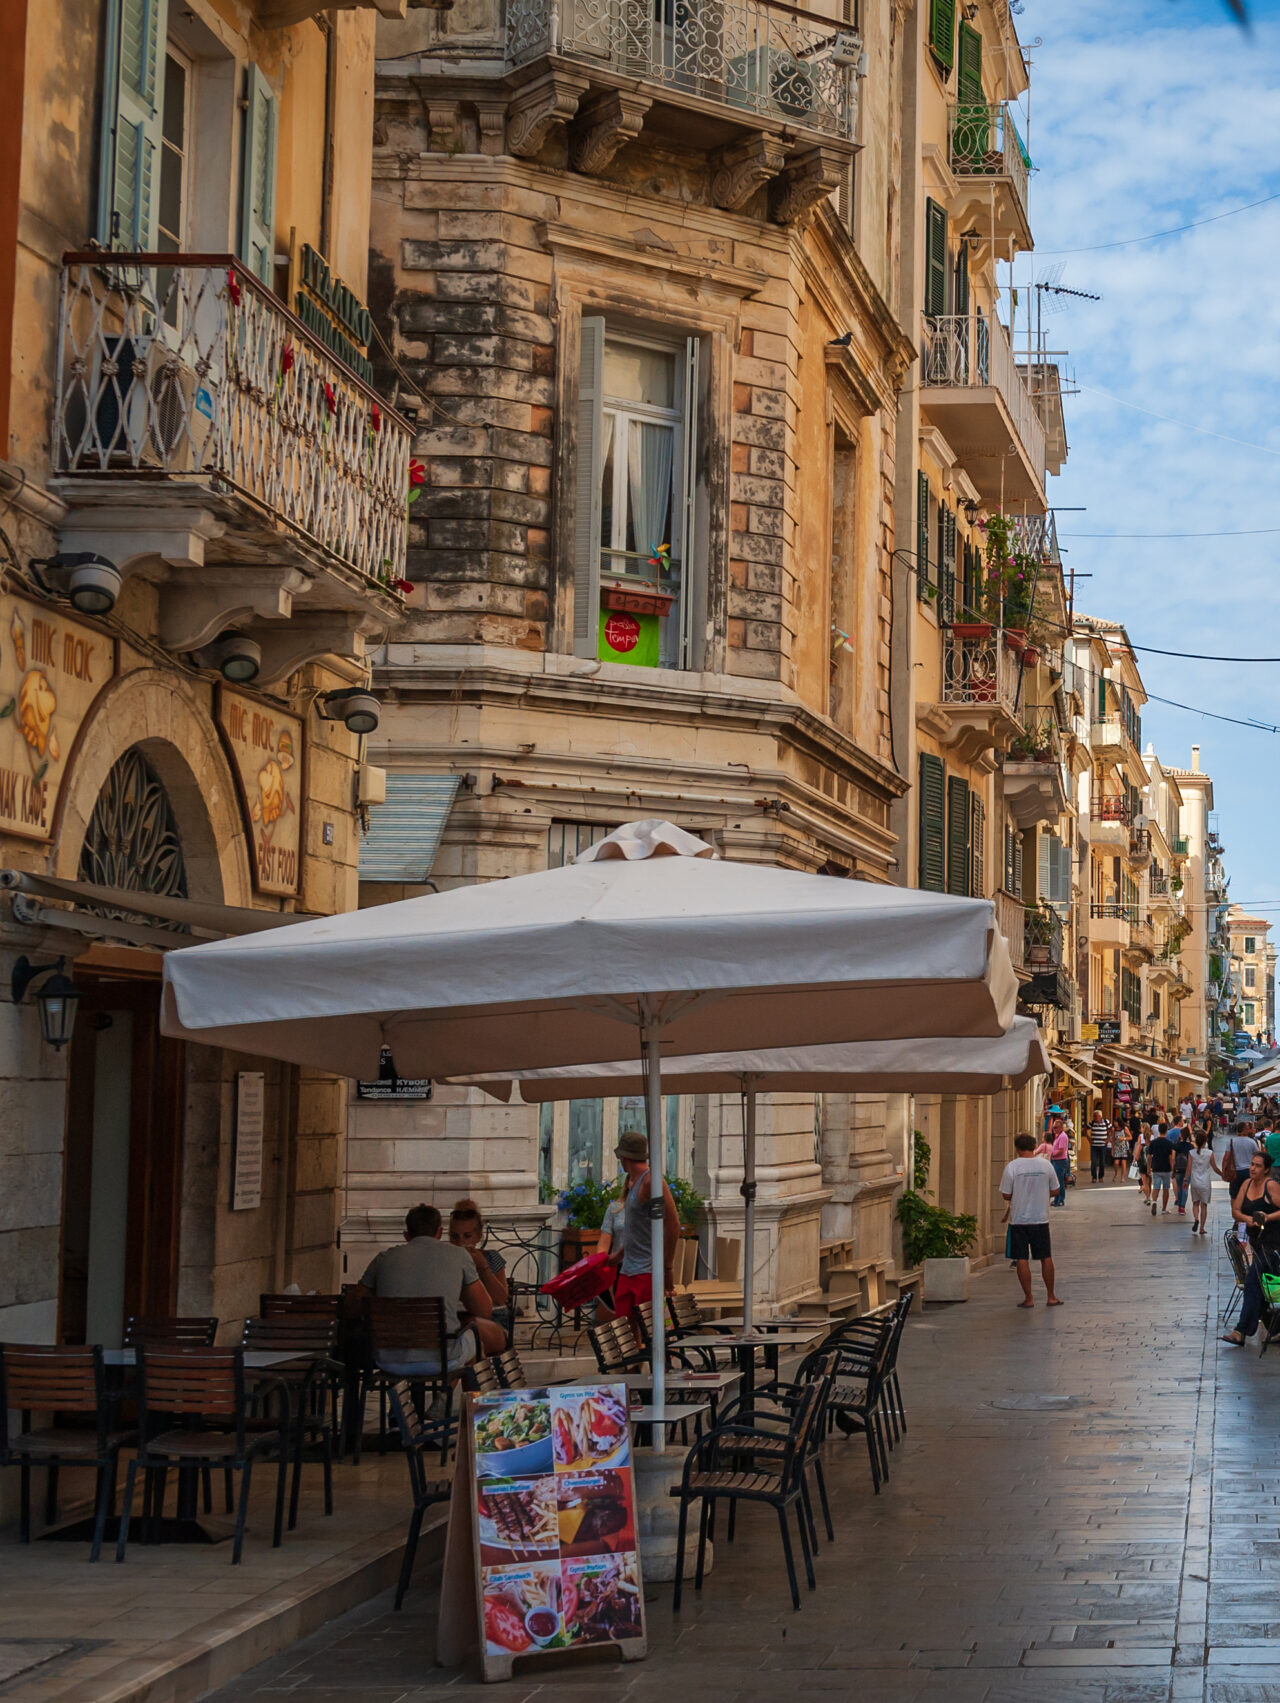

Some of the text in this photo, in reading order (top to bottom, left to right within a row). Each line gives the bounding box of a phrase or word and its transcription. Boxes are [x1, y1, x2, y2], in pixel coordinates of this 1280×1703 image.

[840, 40, 860, 50] ALARM
[842, 48, 855, 56] BOX
[257, 842, 295, 886] FAST FOOD
